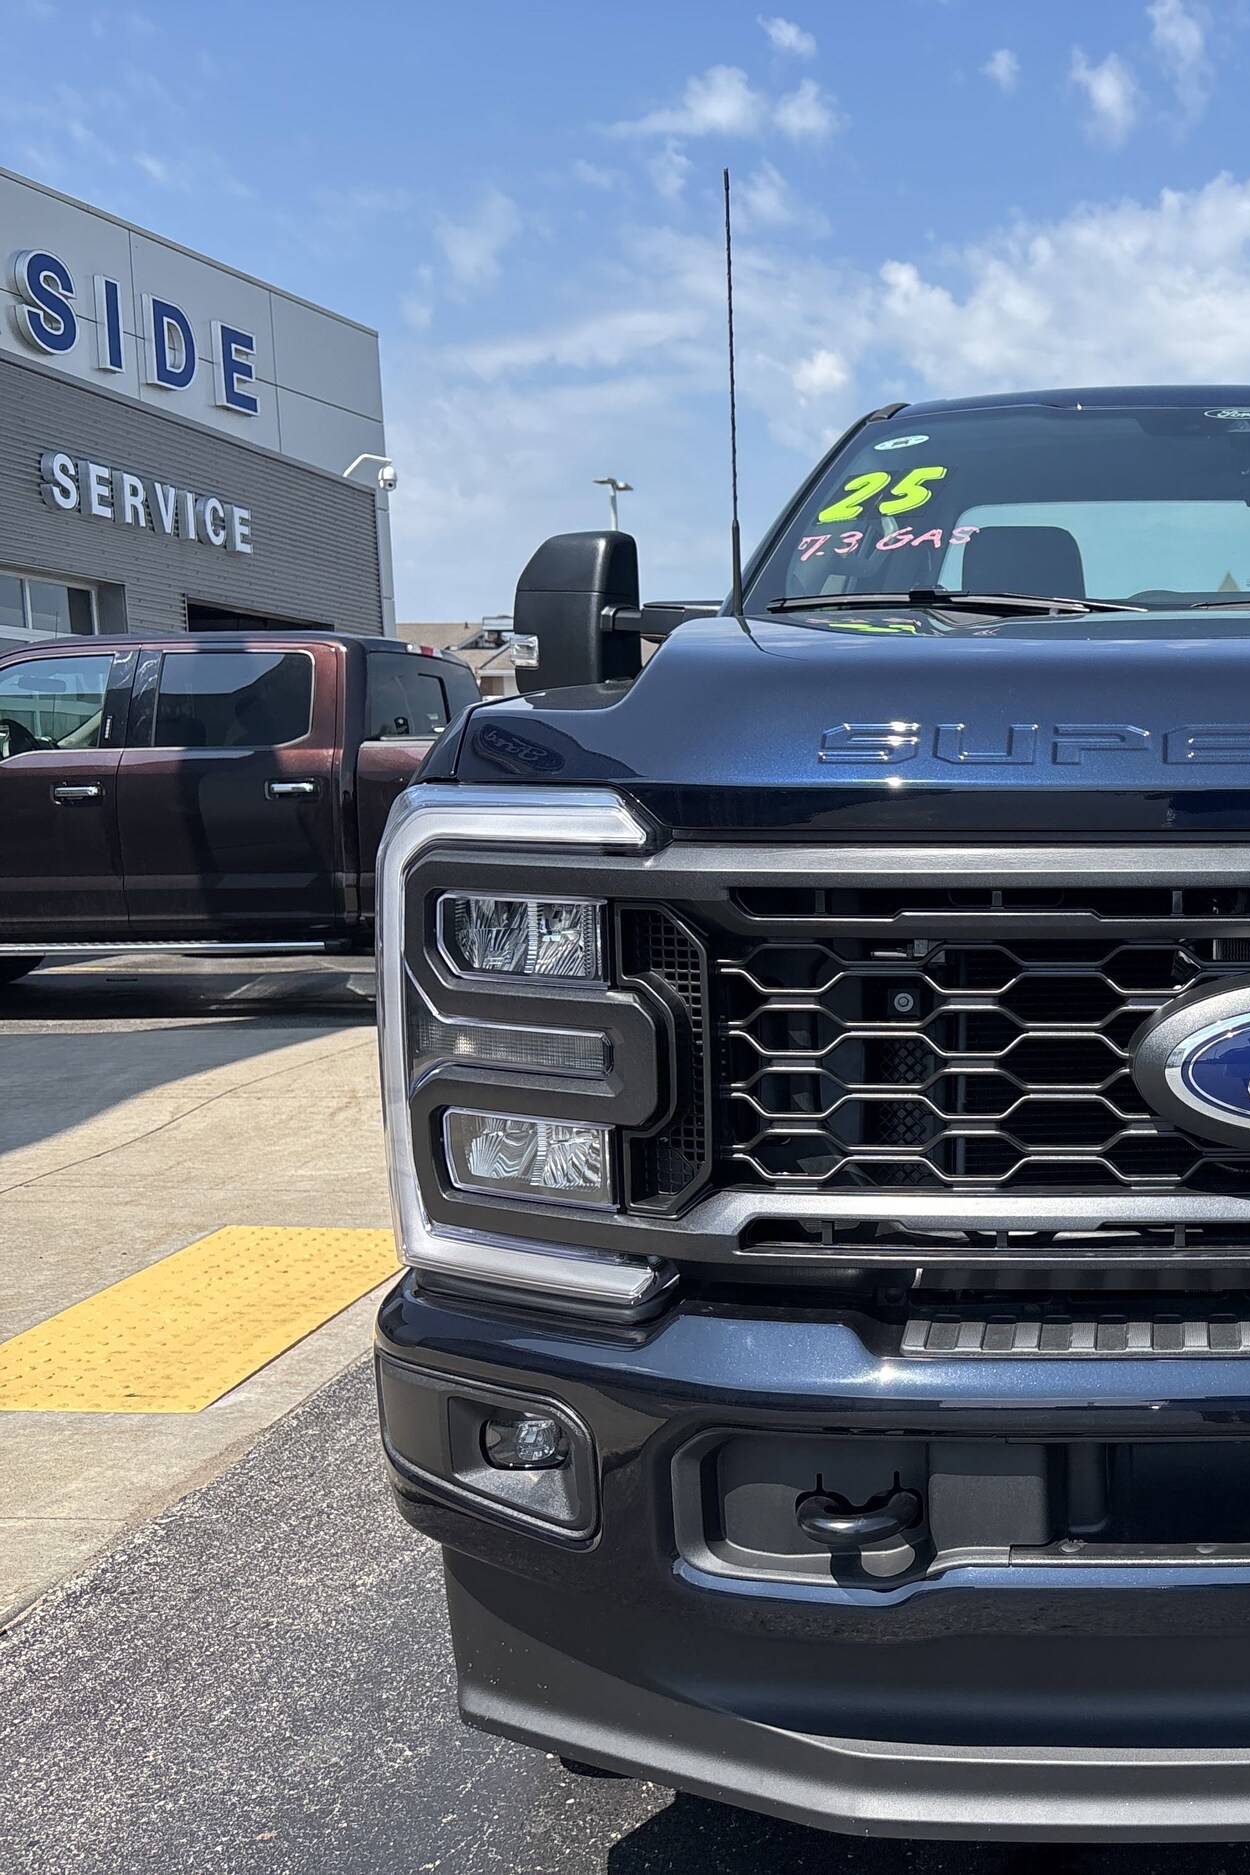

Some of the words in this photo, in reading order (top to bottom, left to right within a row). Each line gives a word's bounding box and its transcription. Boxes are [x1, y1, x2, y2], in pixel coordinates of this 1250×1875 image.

[14, 249, 260, 417] SIDE
[41, 451, 253, 554] SERVICE
[817, 466, 947, 524] 25
[798, 531, 864, 561] 7.3
[876, 527, 980, 550] GAS
